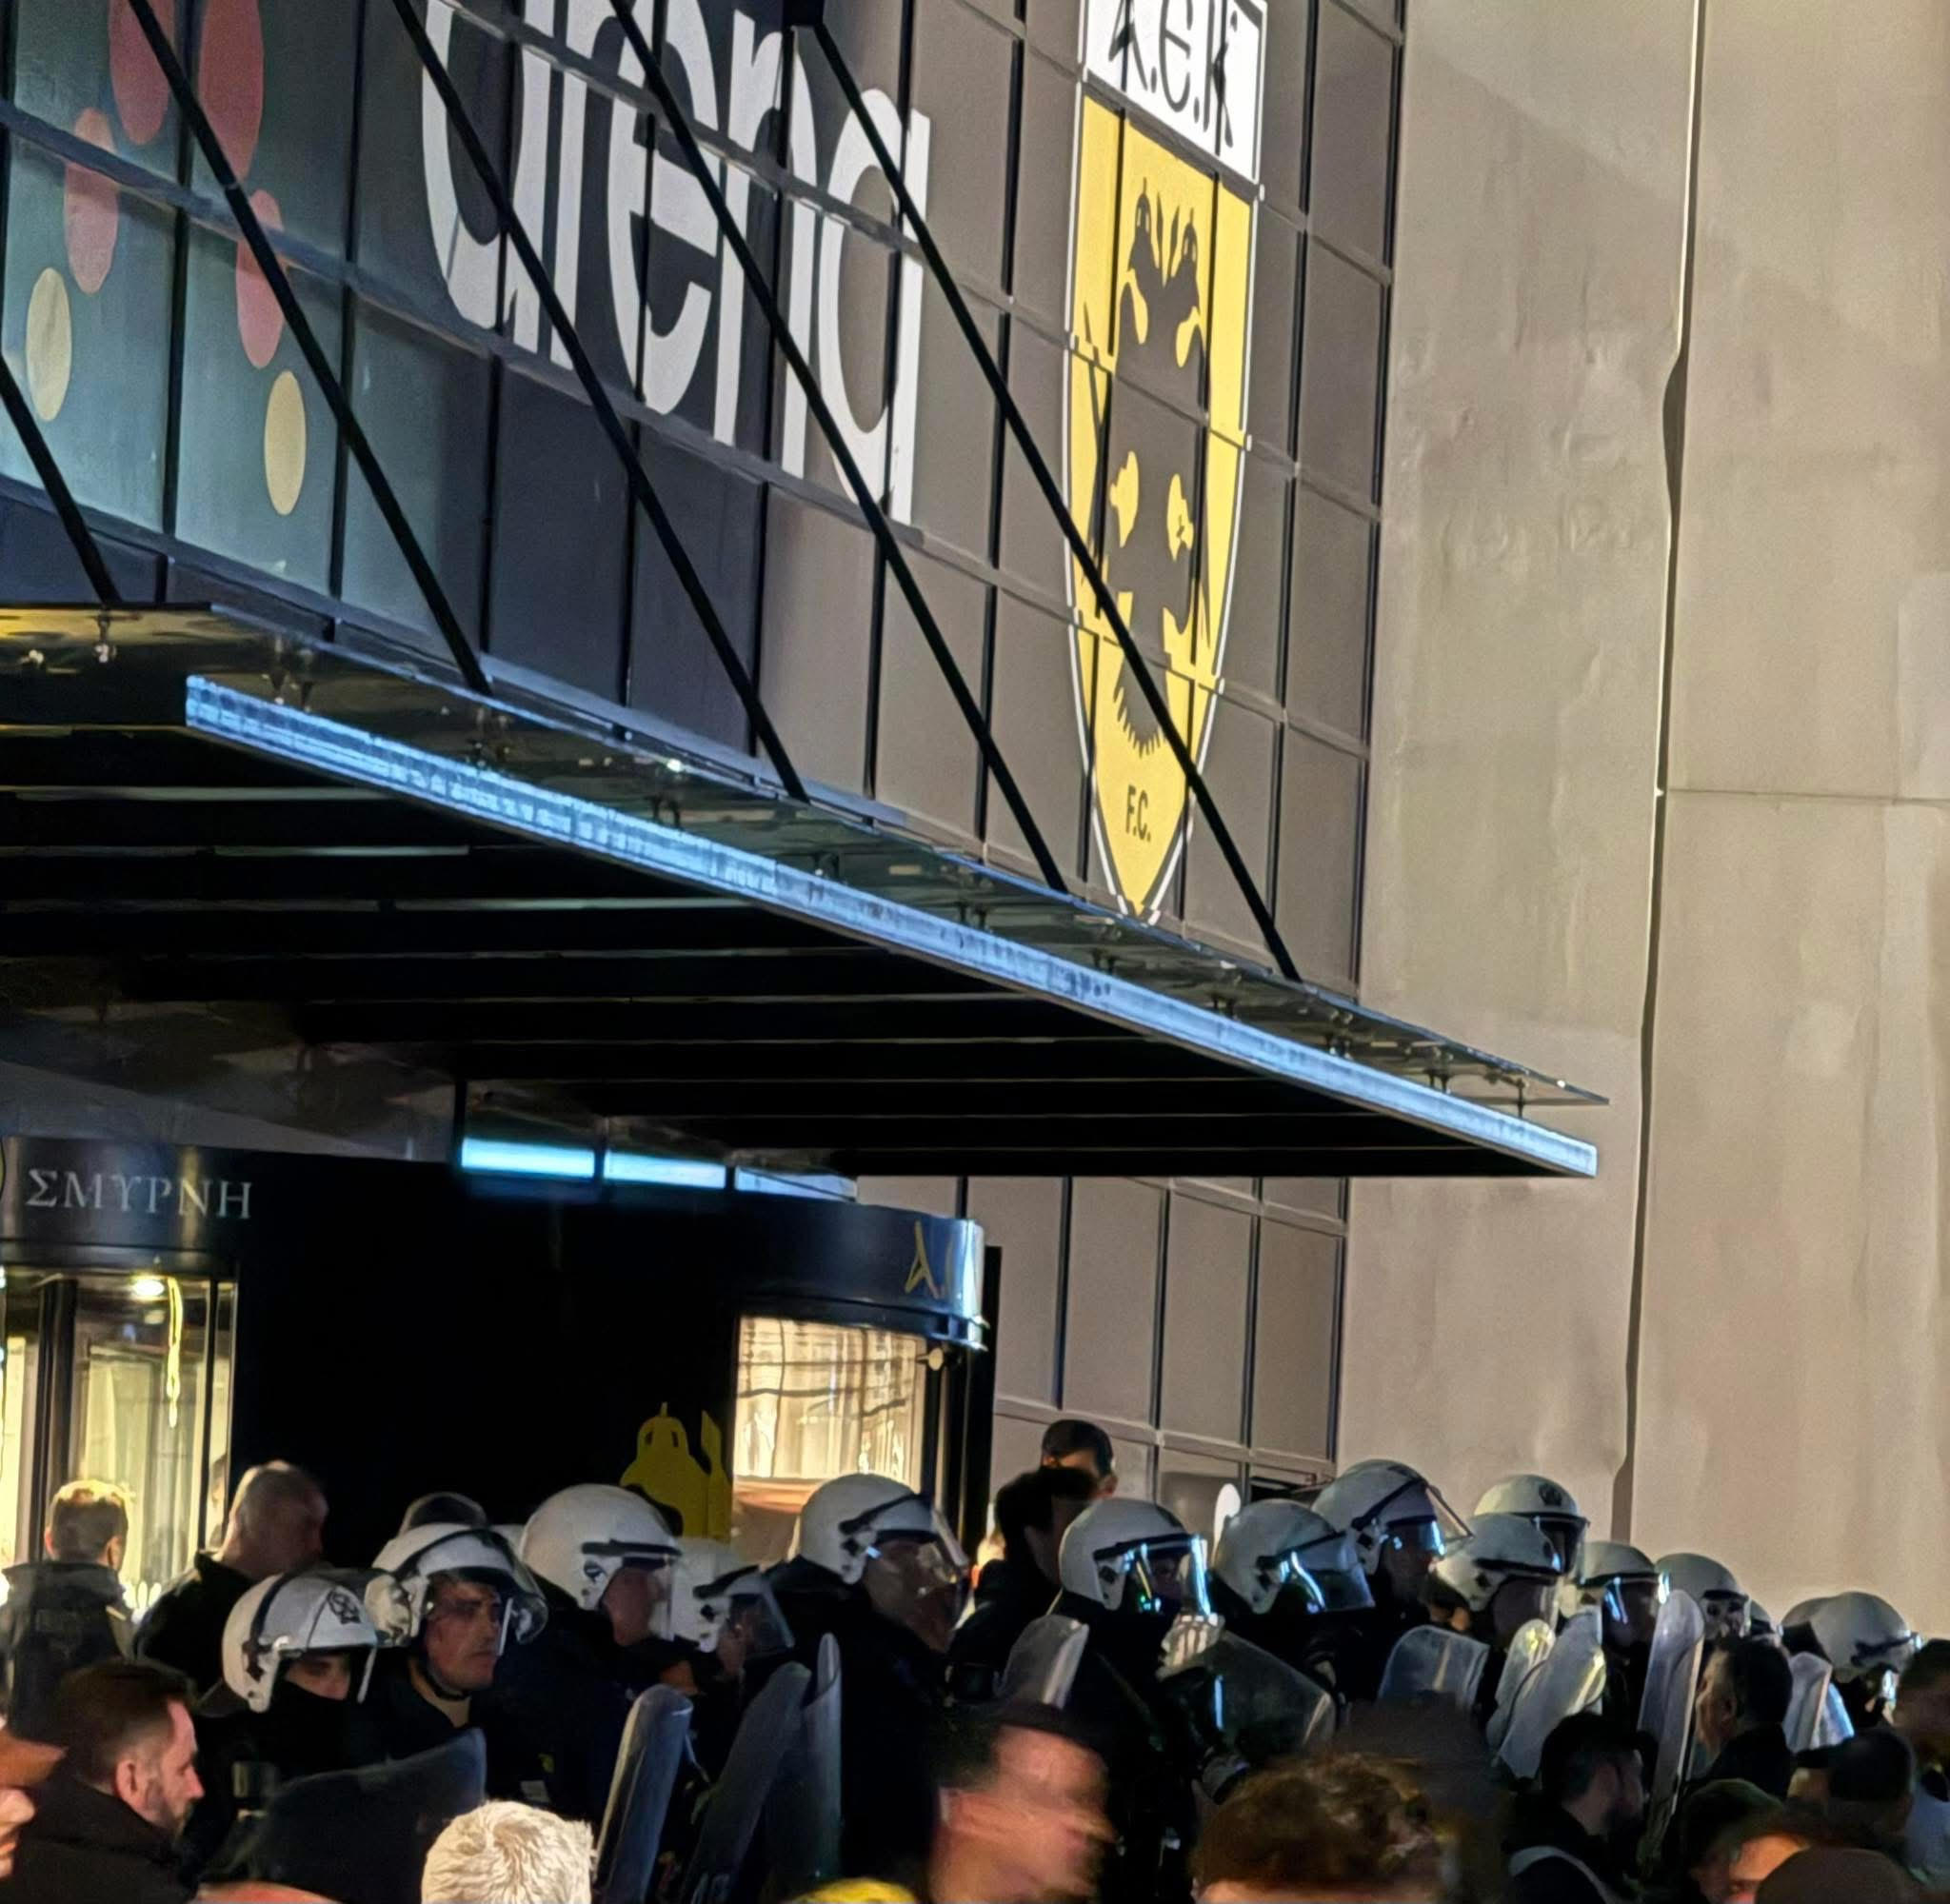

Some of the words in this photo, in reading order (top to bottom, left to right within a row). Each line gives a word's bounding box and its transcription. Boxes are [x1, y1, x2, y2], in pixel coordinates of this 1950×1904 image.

[422, 0, 930, 525] arena
[1125, 783, 1151, 843] F.C.
[26, 1168, 252, 1220] ΣΜΥΡΝΗ
